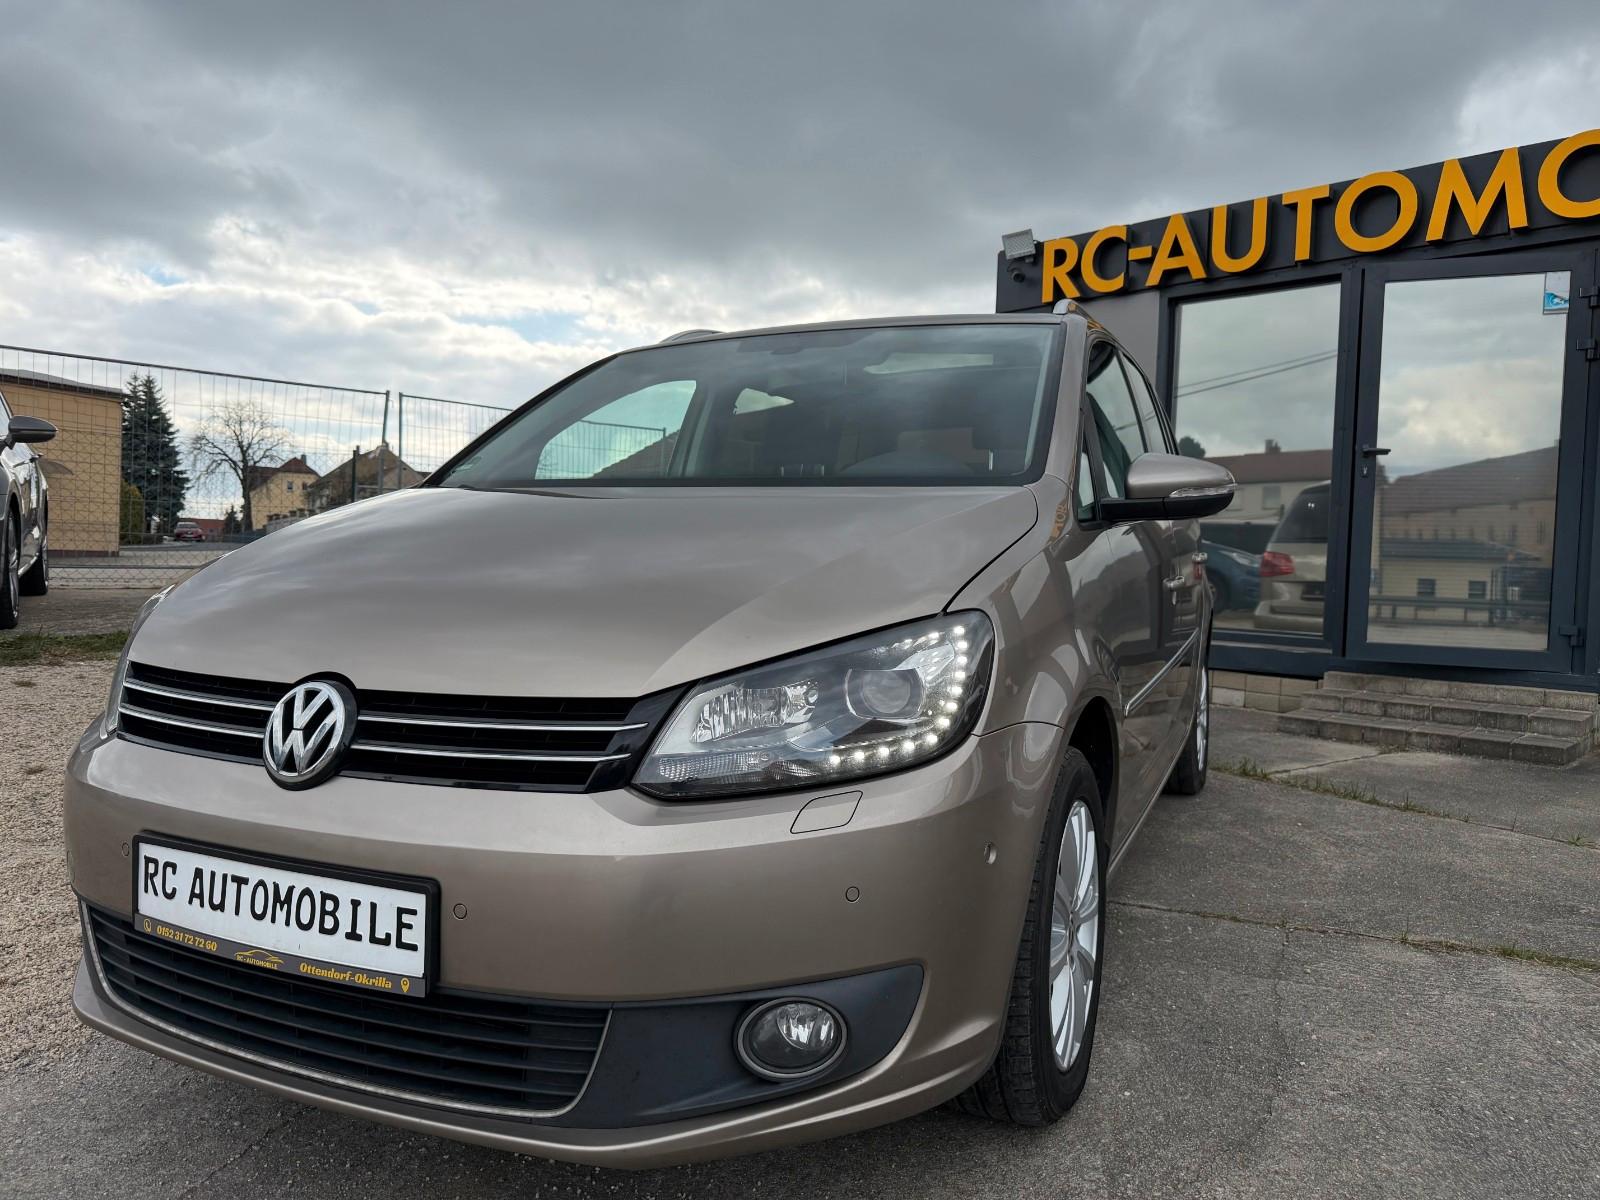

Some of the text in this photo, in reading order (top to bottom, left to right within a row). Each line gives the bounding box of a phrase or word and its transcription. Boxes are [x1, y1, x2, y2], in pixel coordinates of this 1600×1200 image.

[143, 855, 419, 952] RC AUTOMOBILE
[156, 925, 174, 939] 0152
[174, 931, 183, 942] 31
[184, 934, 195, 945] 72
[195, 937, 206, 948] 72
[299, 962, 393, 989] Ottendorf-Okrilla
